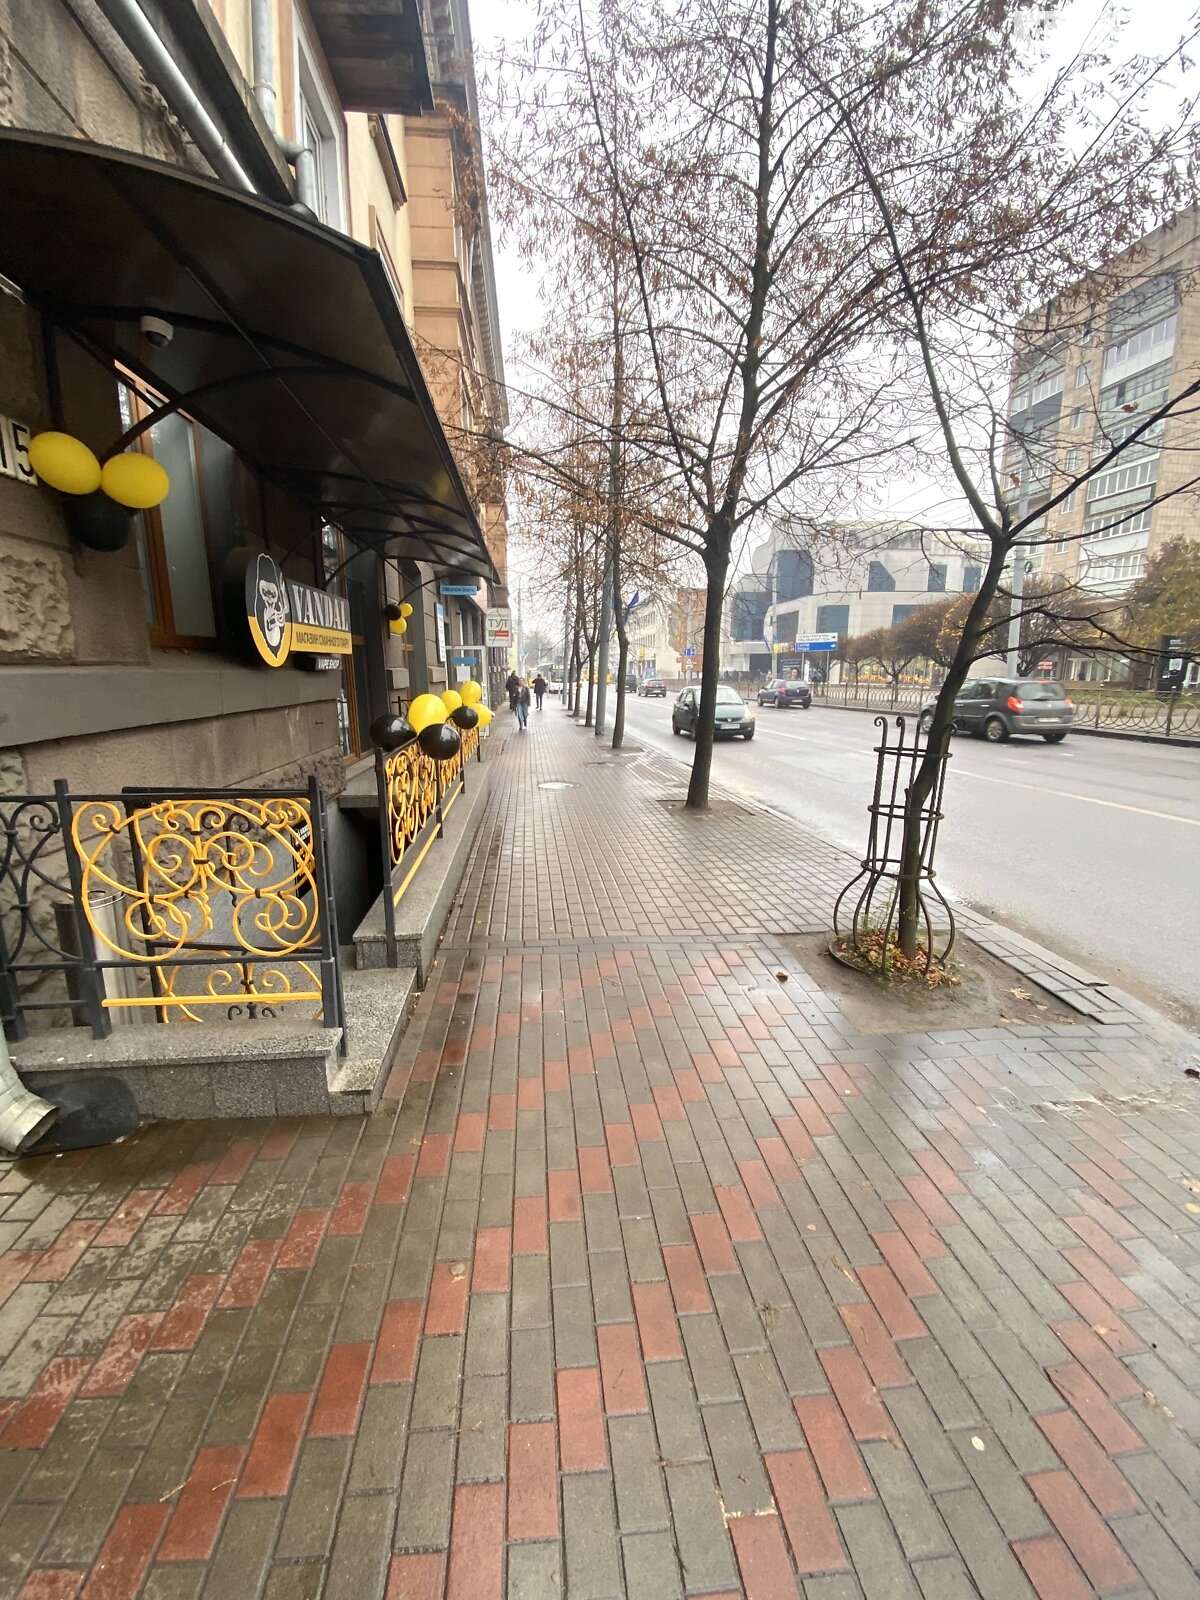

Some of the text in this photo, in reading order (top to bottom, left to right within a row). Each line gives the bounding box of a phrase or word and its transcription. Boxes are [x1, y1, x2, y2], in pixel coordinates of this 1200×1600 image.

[292, 584, 349, 631] VANDAL
[488, 619, 508, 627] ТУТ
[296, 632, 318, 644] МАГАЗИН
[318, 659, 340, 669] VAPE SHOP
